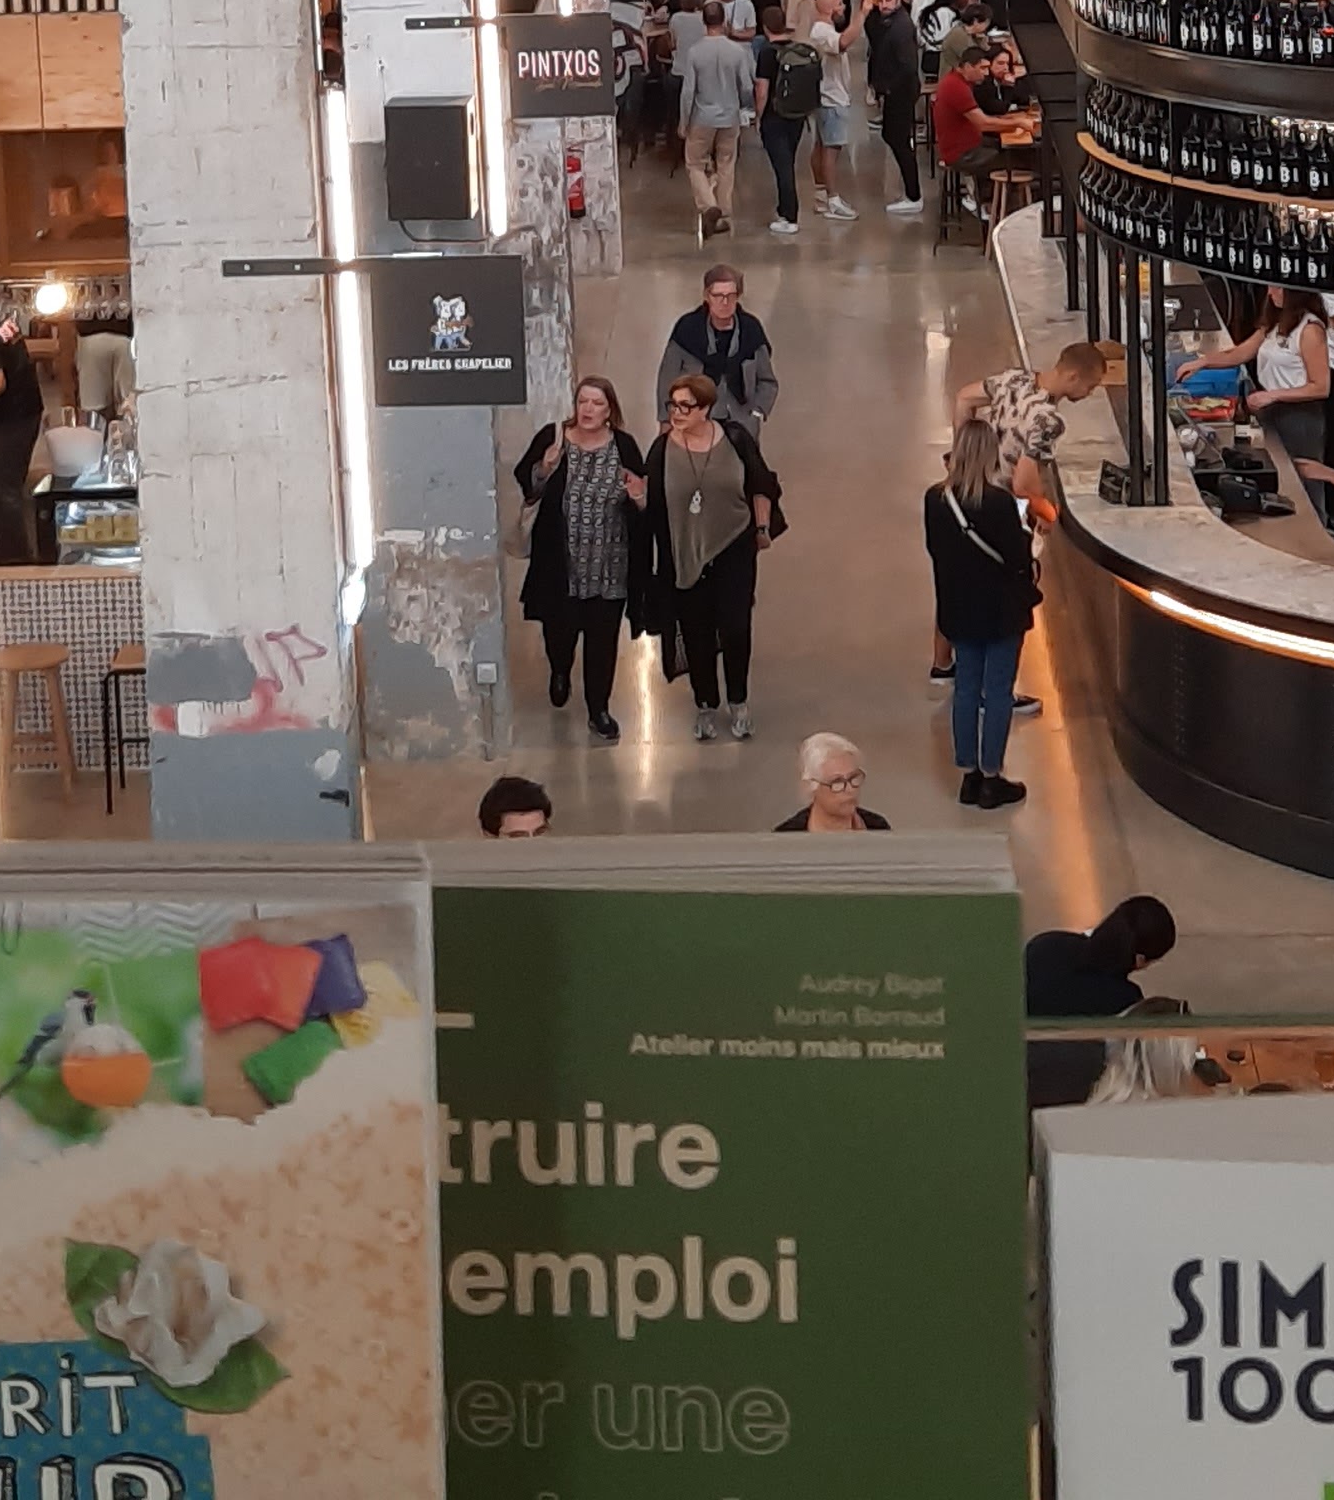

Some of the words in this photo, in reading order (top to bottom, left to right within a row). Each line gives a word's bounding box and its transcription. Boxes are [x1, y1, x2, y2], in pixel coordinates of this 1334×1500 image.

[518, 49, 601, 78] PINTXOS
[774, 1004, 849, 1026] Martin
[629, 1033, 715, 1057] Atelier
[720, 1036, 797, 1058] moins
[800, 1037, 863, 1059] mais
[867, 1040, 945, 1060] mieux
[447, 1235, 799, 1340] emploi
[454, 1379, 565, 1448] er
[592, 1383, 791, 1455] une
